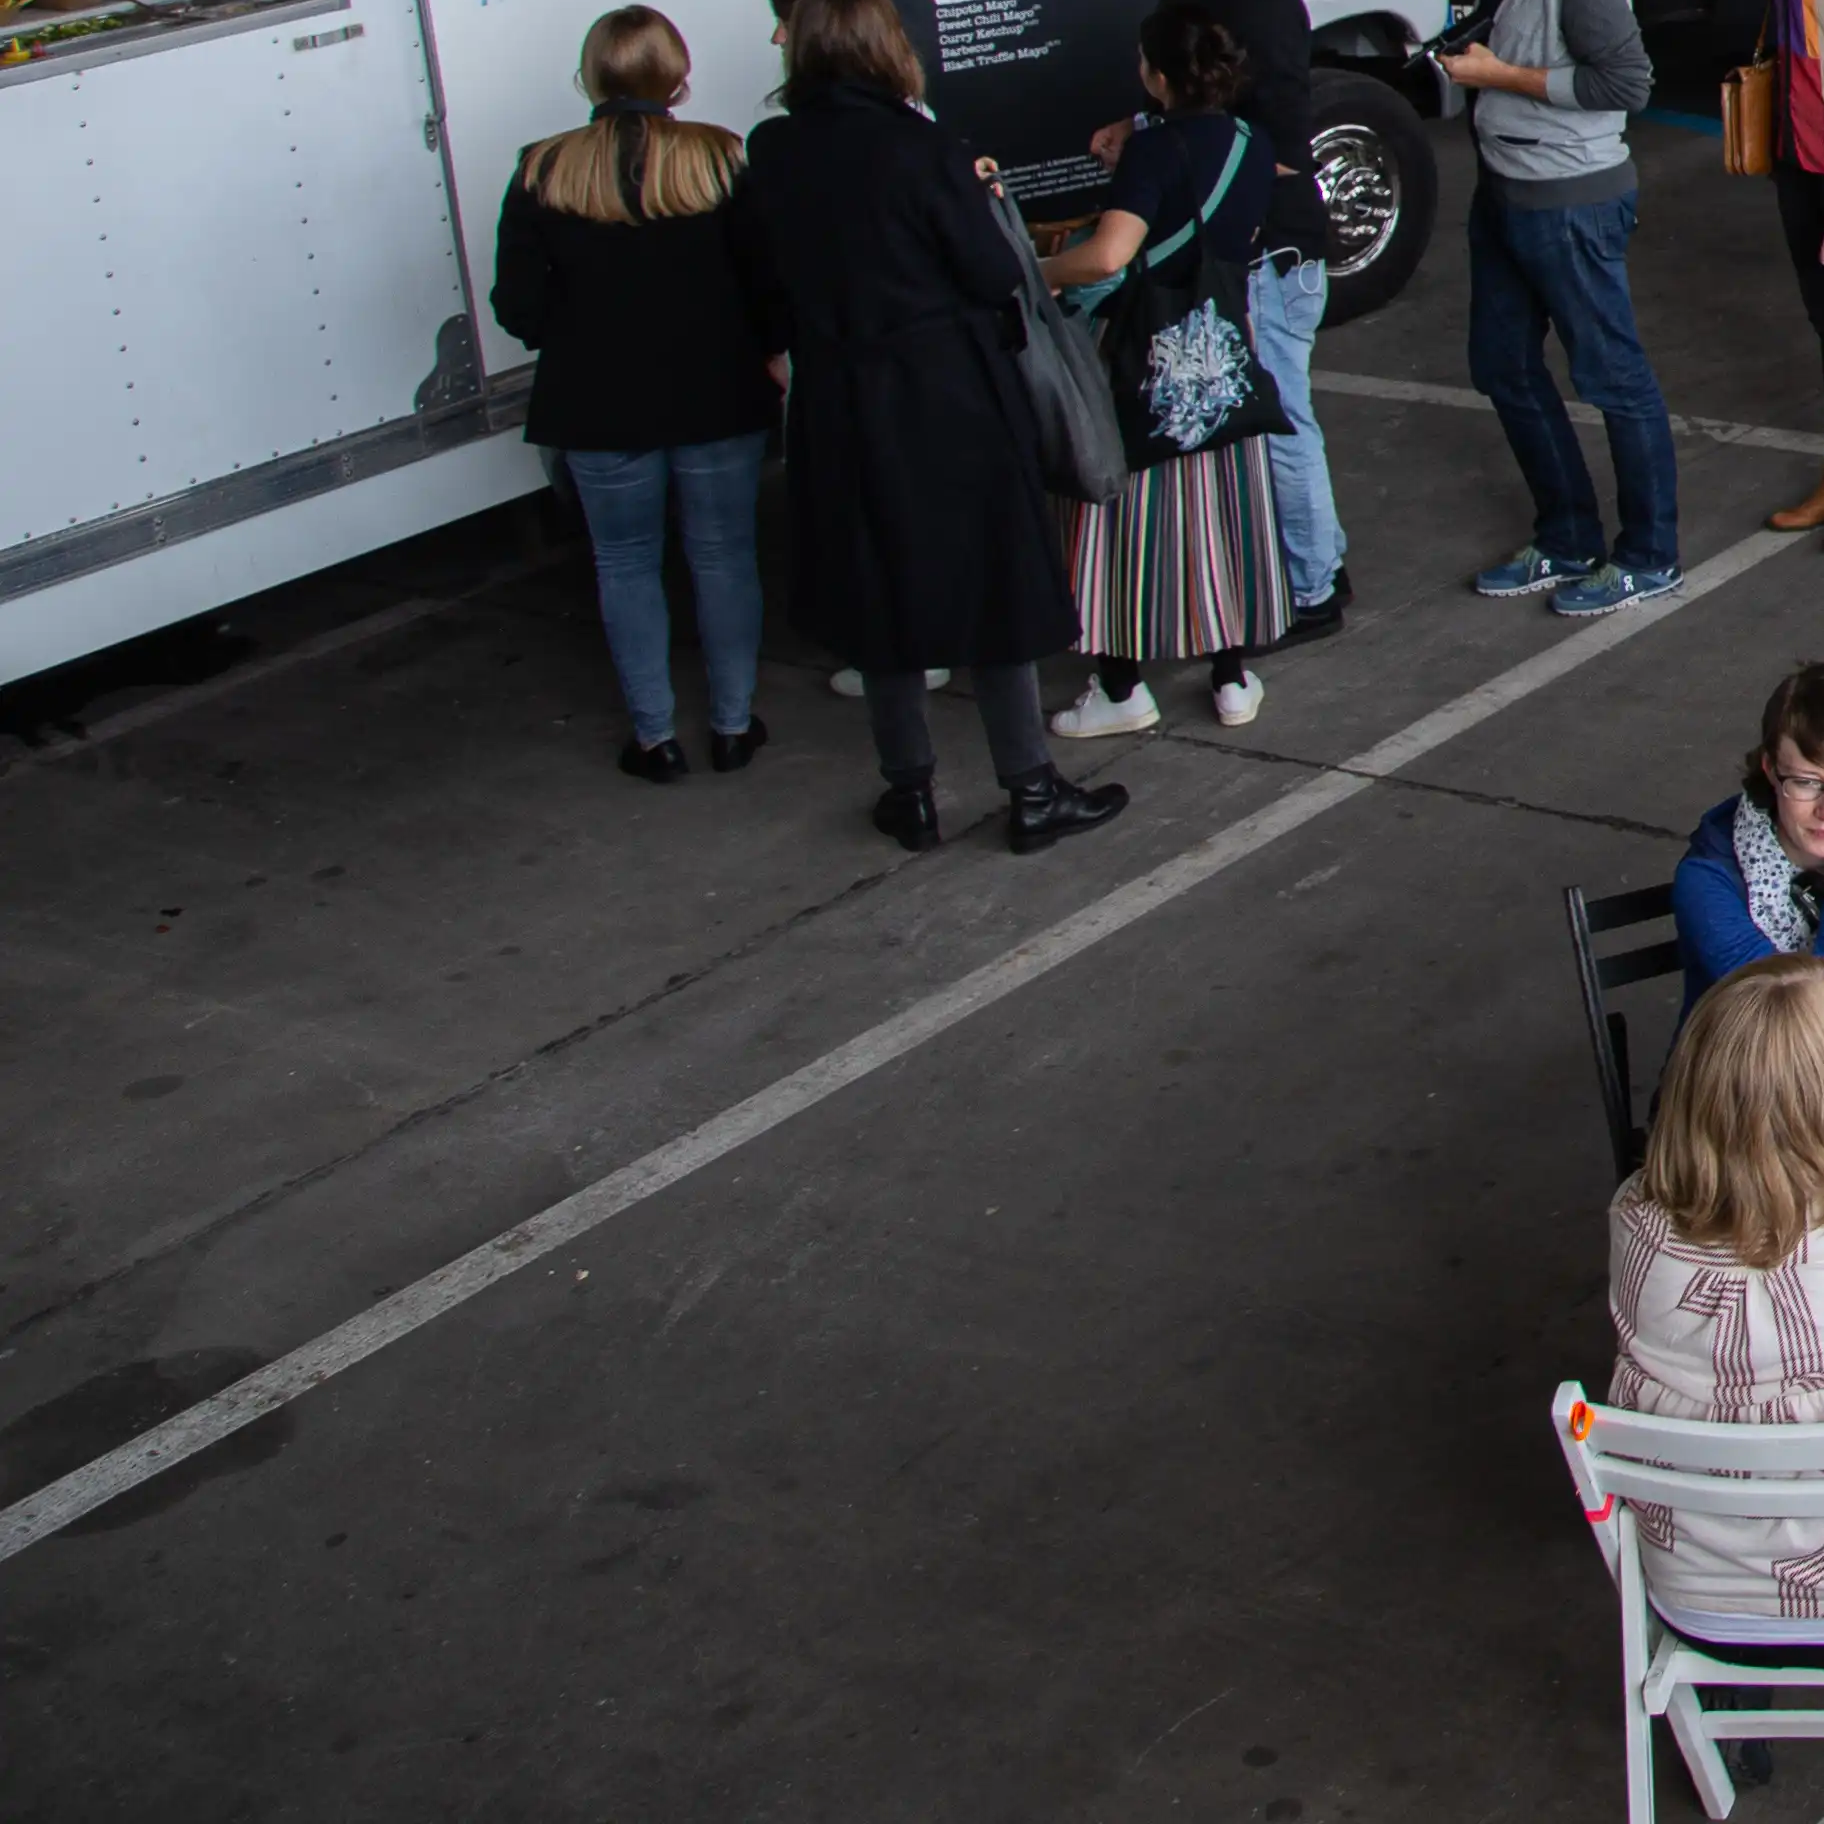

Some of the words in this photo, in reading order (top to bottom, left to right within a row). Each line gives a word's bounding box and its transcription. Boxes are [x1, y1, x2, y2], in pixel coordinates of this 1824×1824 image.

[936, 3, 984, 20] Chipotle
[938, 18, 973, 33] Sweet
[974, 12, 1001, 26] Chili
[939, 32, 974, 46] Curry
[976, 23, 1025, 40] Ketchup
[943, 58, 975, 72] Black
[976, 50, 1016, 66] Truffle
